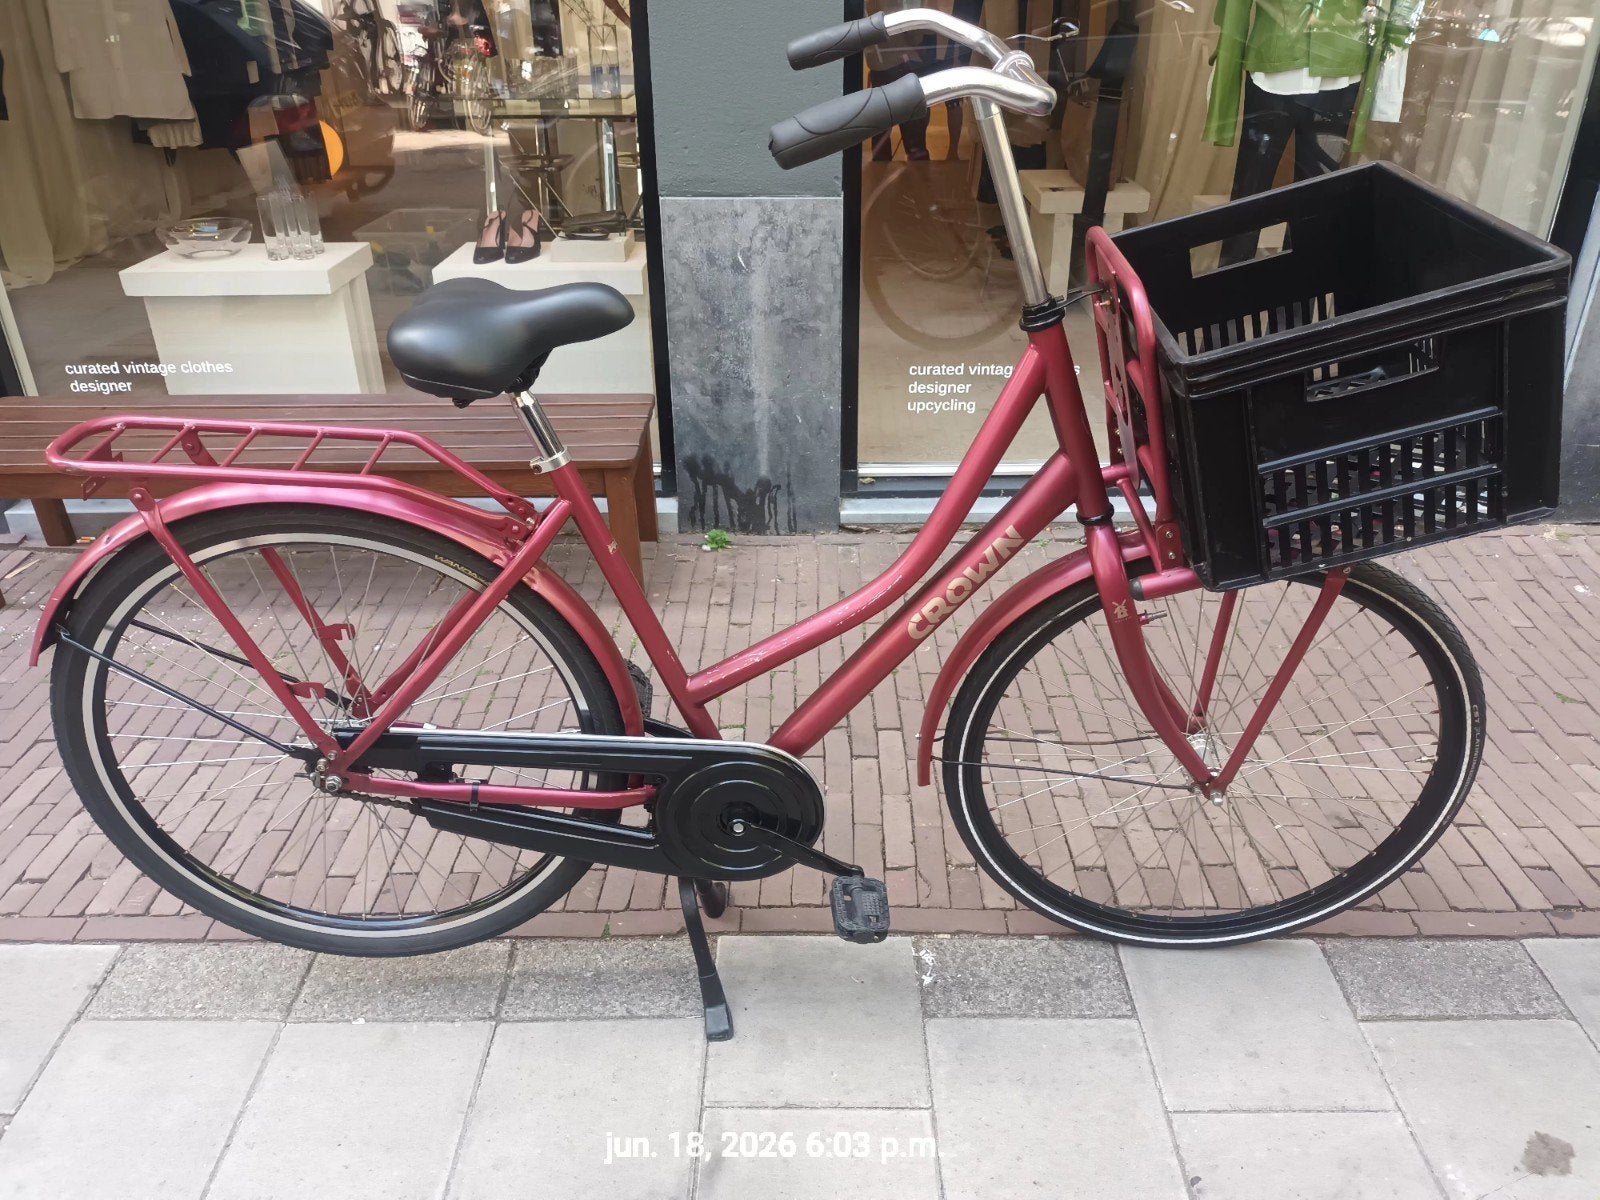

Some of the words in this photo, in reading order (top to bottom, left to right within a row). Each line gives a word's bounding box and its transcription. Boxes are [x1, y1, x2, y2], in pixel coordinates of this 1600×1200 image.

[64, 361, 120, 375] curated
[122, 361, 177, 376] vintage
[180, 360, 234, 373] clothes
[909, 363, 964, 376] curated
[968, 363, 1014, 378] vintag
[70, 380, 133, 395] designer
[908, 381, 972, 396] designer
[907, 399, 976, 414] upcycling
[907, 524, 1025, 640] CROWN
